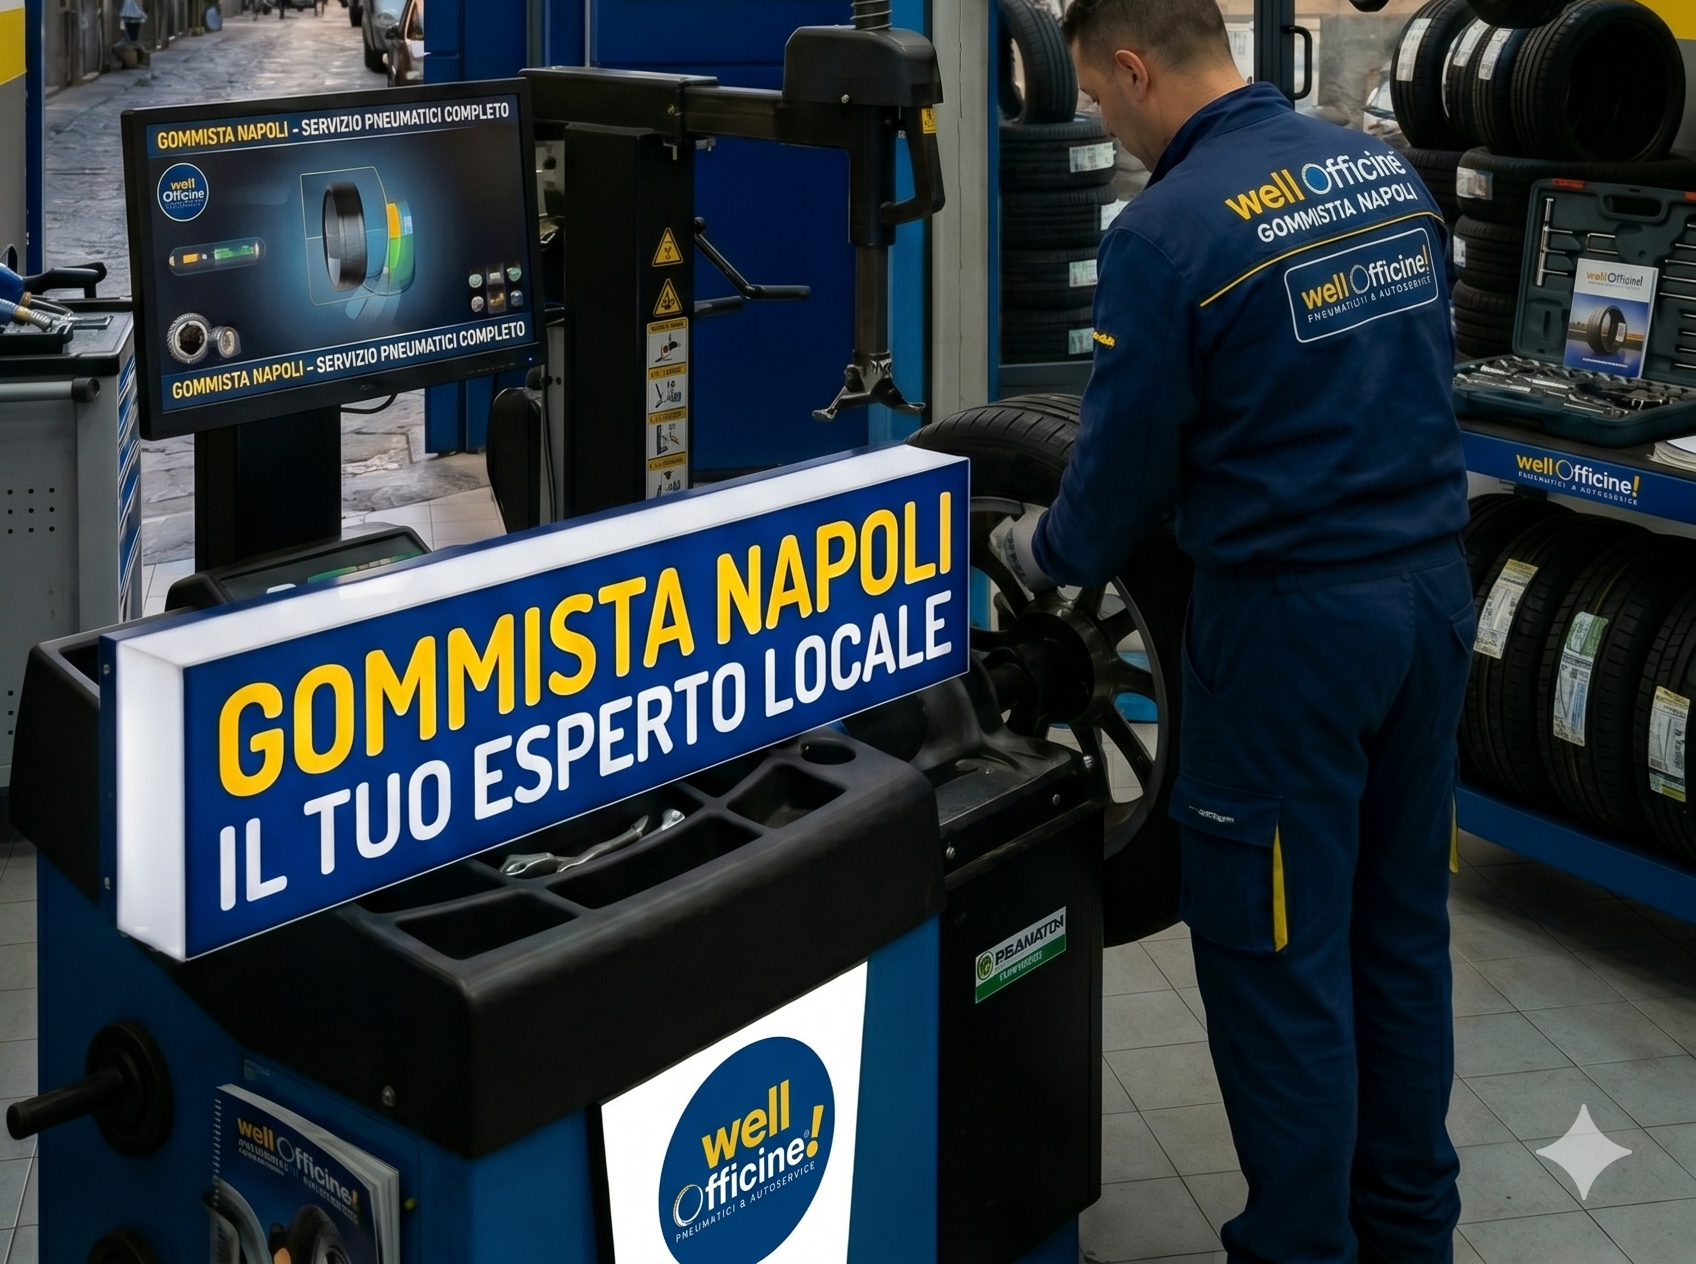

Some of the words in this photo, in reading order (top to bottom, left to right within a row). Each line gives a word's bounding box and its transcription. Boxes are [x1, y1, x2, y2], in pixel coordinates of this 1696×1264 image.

[157, 126, 235, 150] GOMMISTA
[237, 121, 288, 142] NAPOLI
[301, 114, 362, 136] SERVIZIO
[365, 107, 442, 130] PNEUMATICI
[444, 102, 510, 122] COMPLETO
[1224, 168, 1306, 221] well
[1356, 182, 1418, 213] NAPOLI
[1301, 272, 1350, 310] well
[172, 370, 250, 399] GOMMISTA
[253, 360, 304, 385] NAPOLI
[316, 347, 377, 373] SERVIZIO
[380, 332, 458, 362] PNEUMATICI
[459, 320, 526, 347] COMPLETO
[1516, 454, 1553, 476] well
[1555, 459, 1640, 498] Officine!
[218, 566, 694, 797] GOMMISTA
[716, 491, 952, 645] NAPOLI
[219, 816, 288, 912] IL
[303, 759, 452, 876] TUO
[474, 661, 746, 821] ESPERTO
[764, 589, 952, 718] LOCALE
[237, 1117, 275, 1152] well
[701, 1079, 790, 1170] well
[675, 1205, 736, 1243] PNEUMATICI
[750, 1160, 815, 1204] AUTOSERVICE
